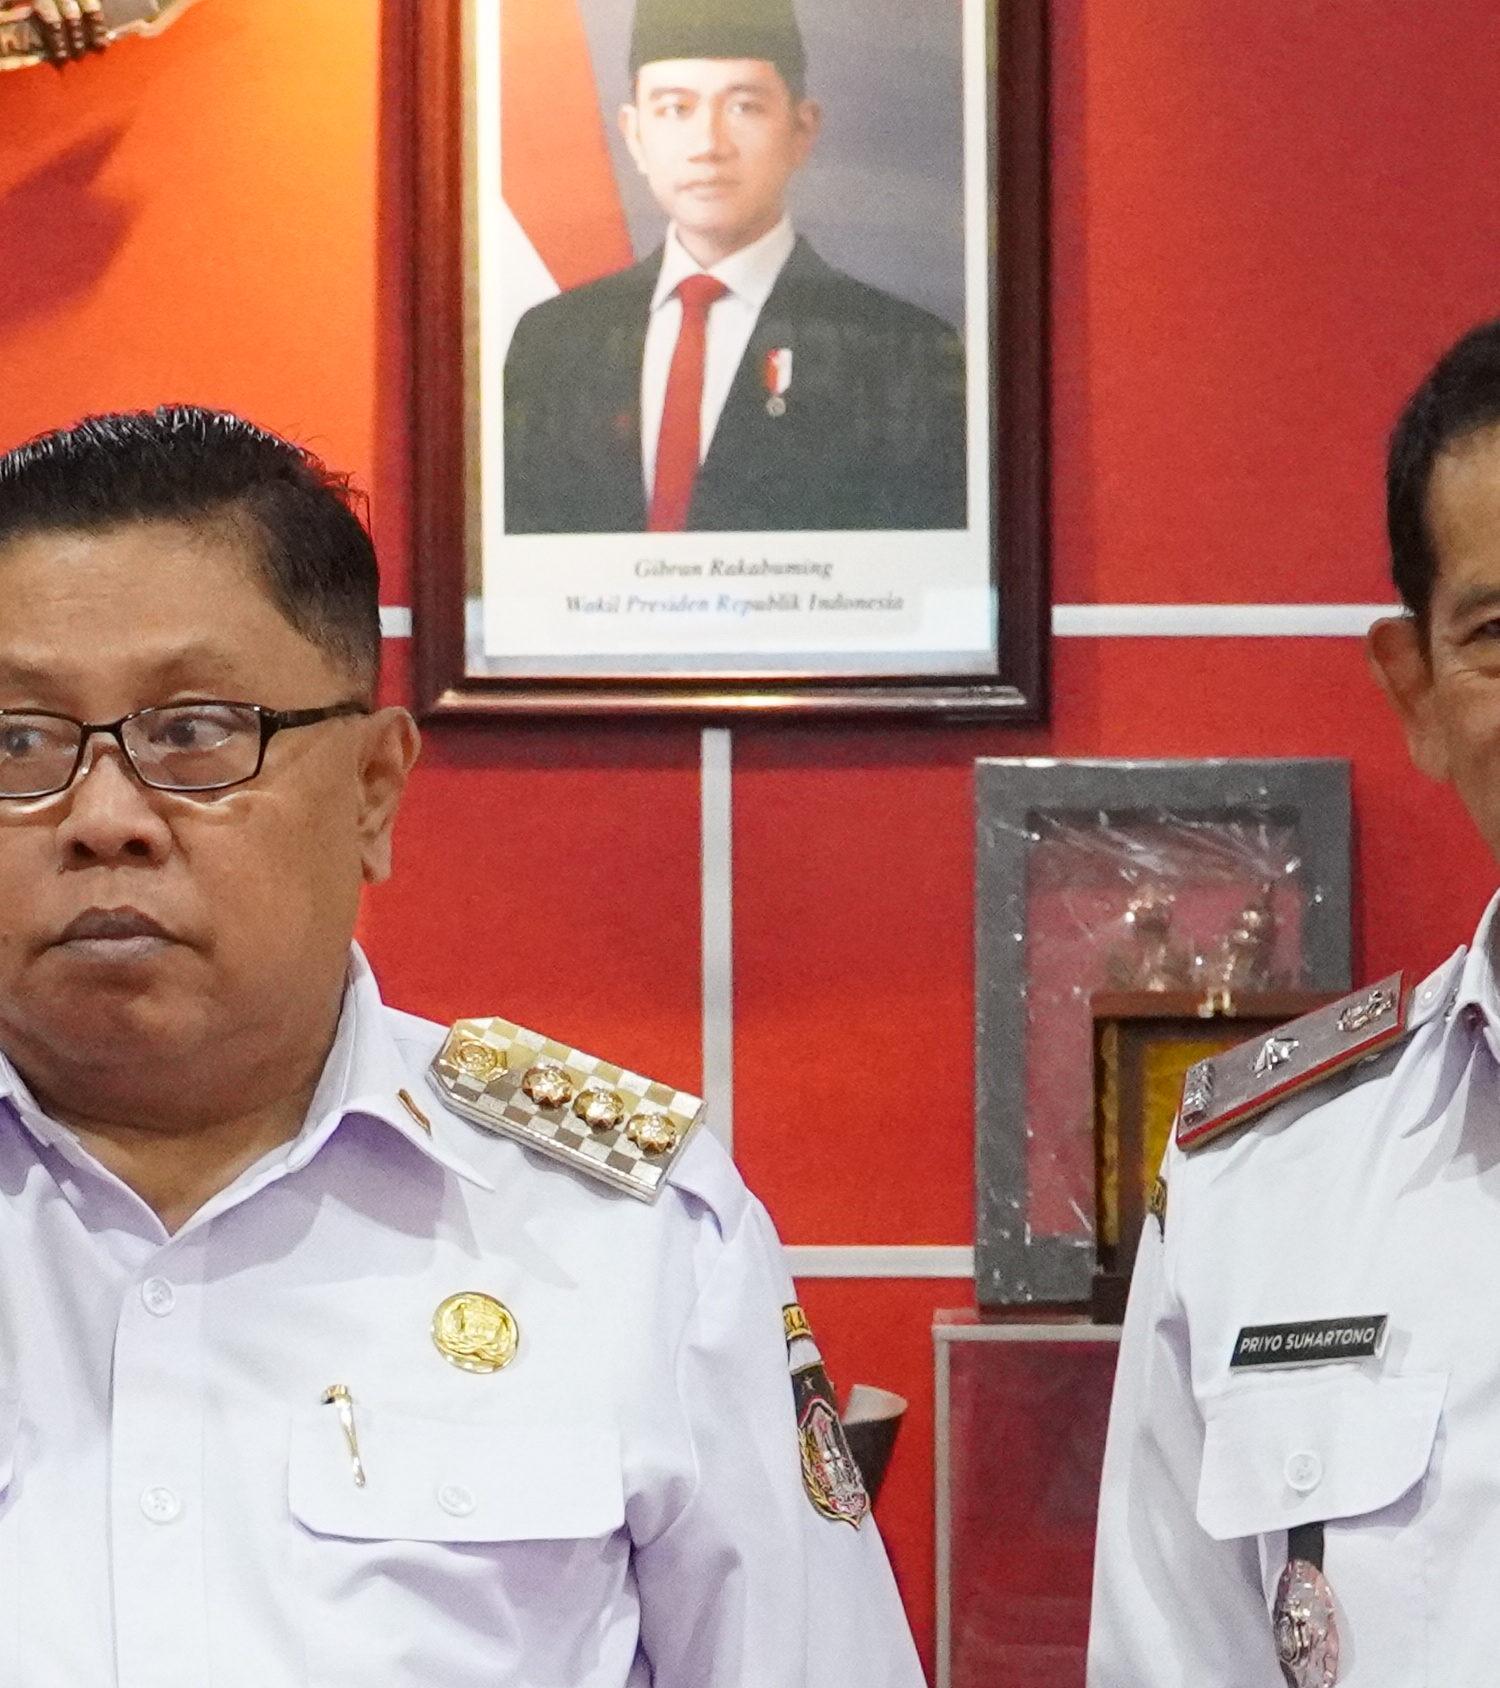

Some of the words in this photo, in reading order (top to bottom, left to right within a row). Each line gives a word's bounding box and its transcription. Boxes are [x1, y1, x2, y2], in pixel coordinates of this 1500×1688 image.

[635, 559, 702, 577] Gibran
[709, 559, 833, 579] Rakabuming
[566, 596, 620, 613] Wakil
[626, 595, 708, 613] Presiden
[716, 594, 801, 617] Republik
[809, 593, 904, 611] Indonesia
[1240, 1334, 1283, 1354] PRIYO
[1285, 1327, 1375, 1350] SUHARTONO
